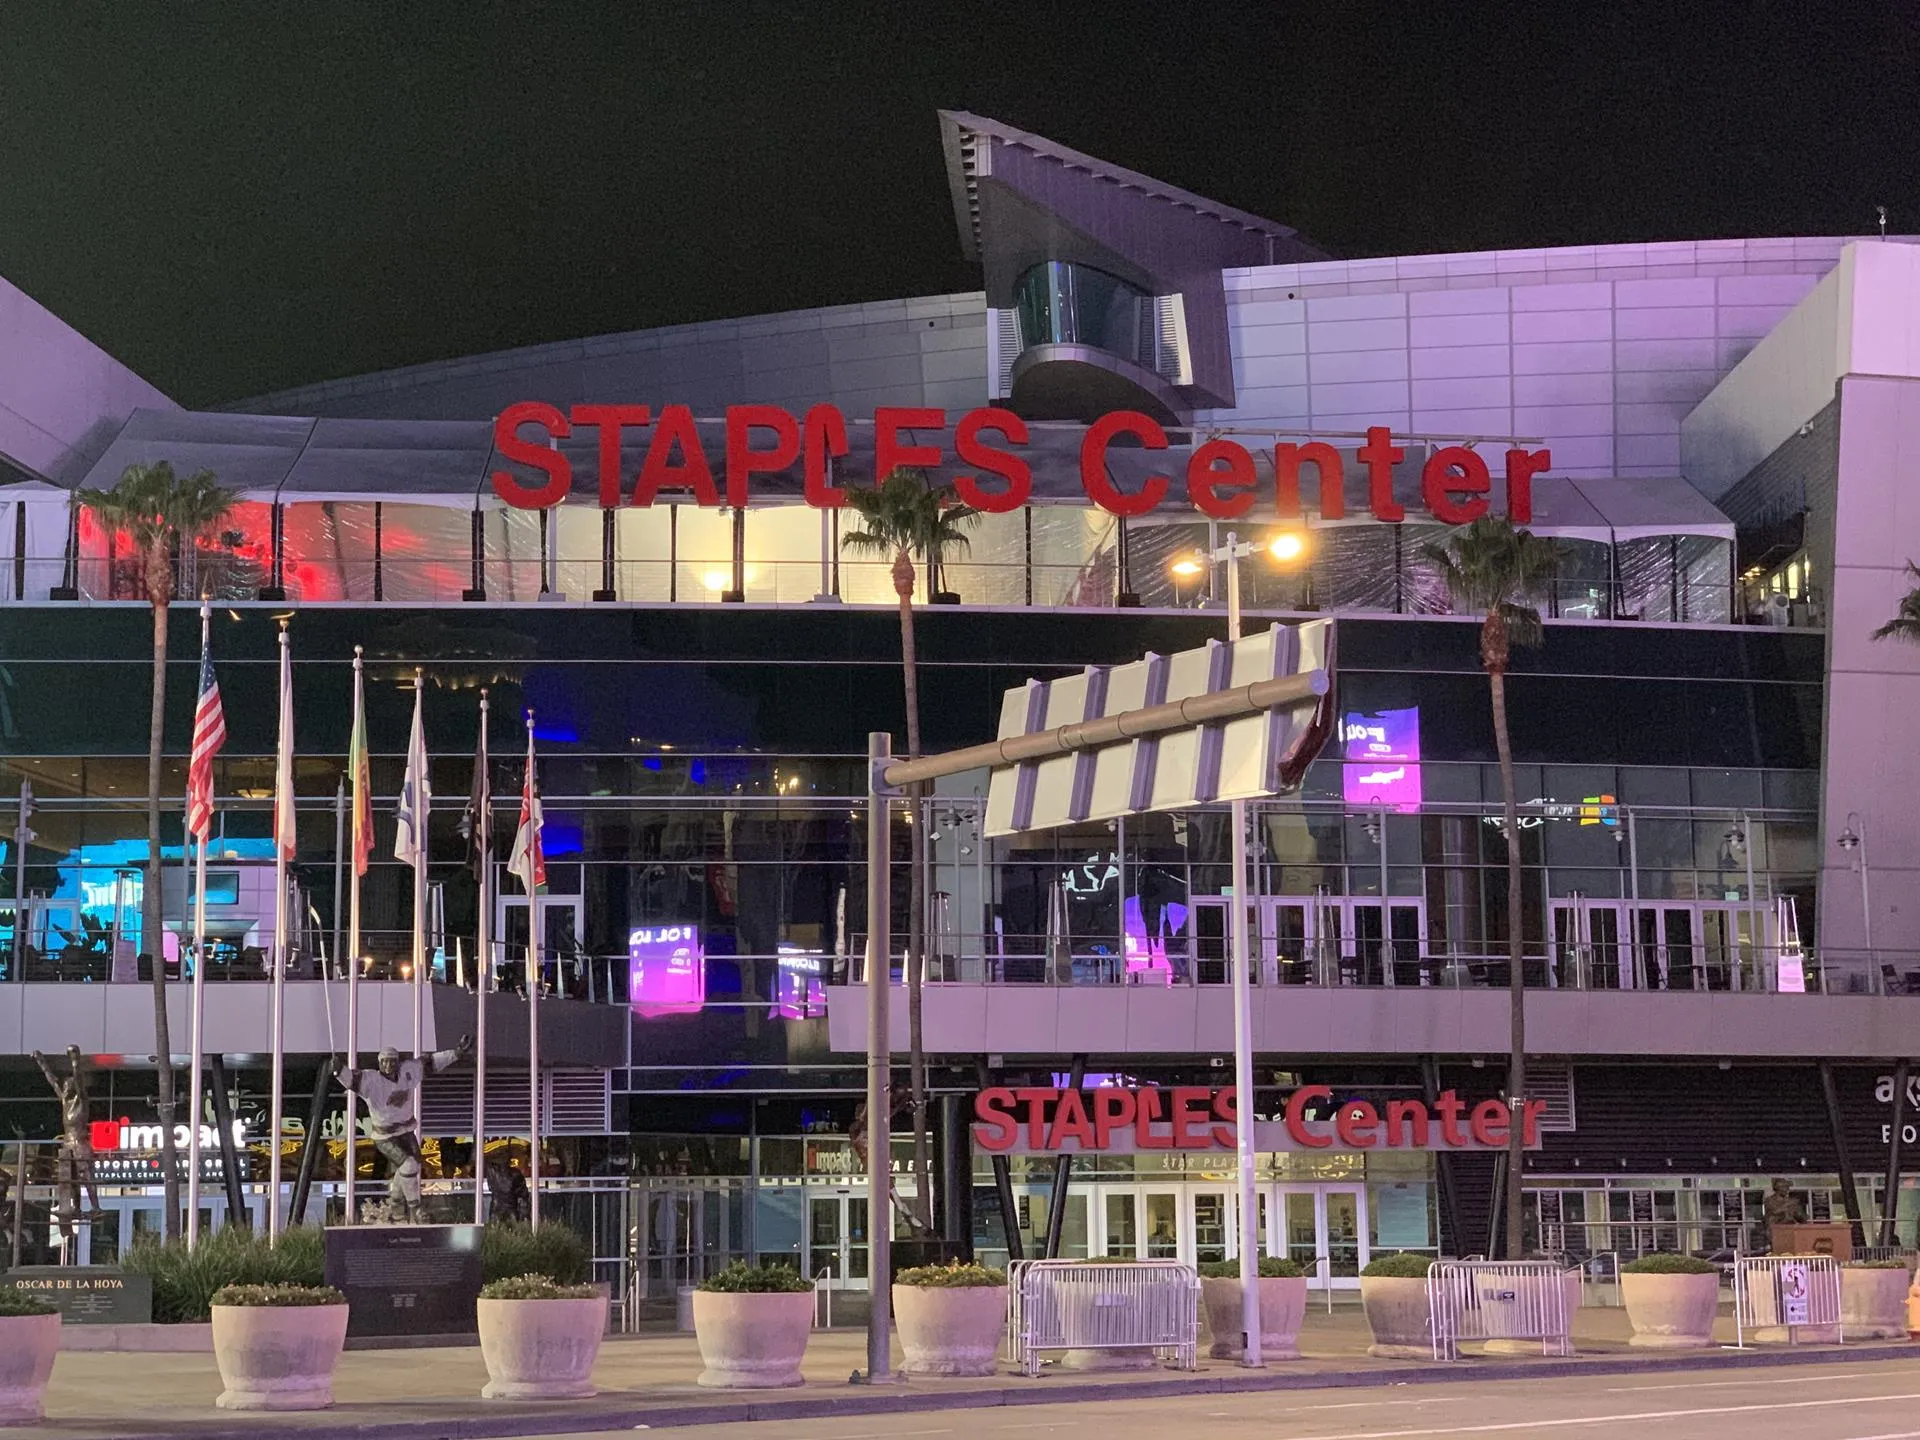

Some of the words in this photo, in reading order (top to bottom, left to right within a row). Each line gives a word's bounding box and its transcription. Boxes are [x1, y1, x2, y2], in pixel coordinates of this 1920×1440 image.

[491, 400, 1033, 513] STAPLES
[1080, 409, 1551, 525] Center
[974, 1086, 1238, 1150] STAPLES
[1285, 1084, 1547, 1148] Center
[94, 1160, 148, 1169] SPORTS
[1203, 1156, 1239, 1168] PLAZ
[15, 1280, 53, 1289] OSCAR
[56, 1280, 72, 1289] DE
[76, 1280, 90, 1289] LA
[94, 1279, 124, 1289] HOYA
